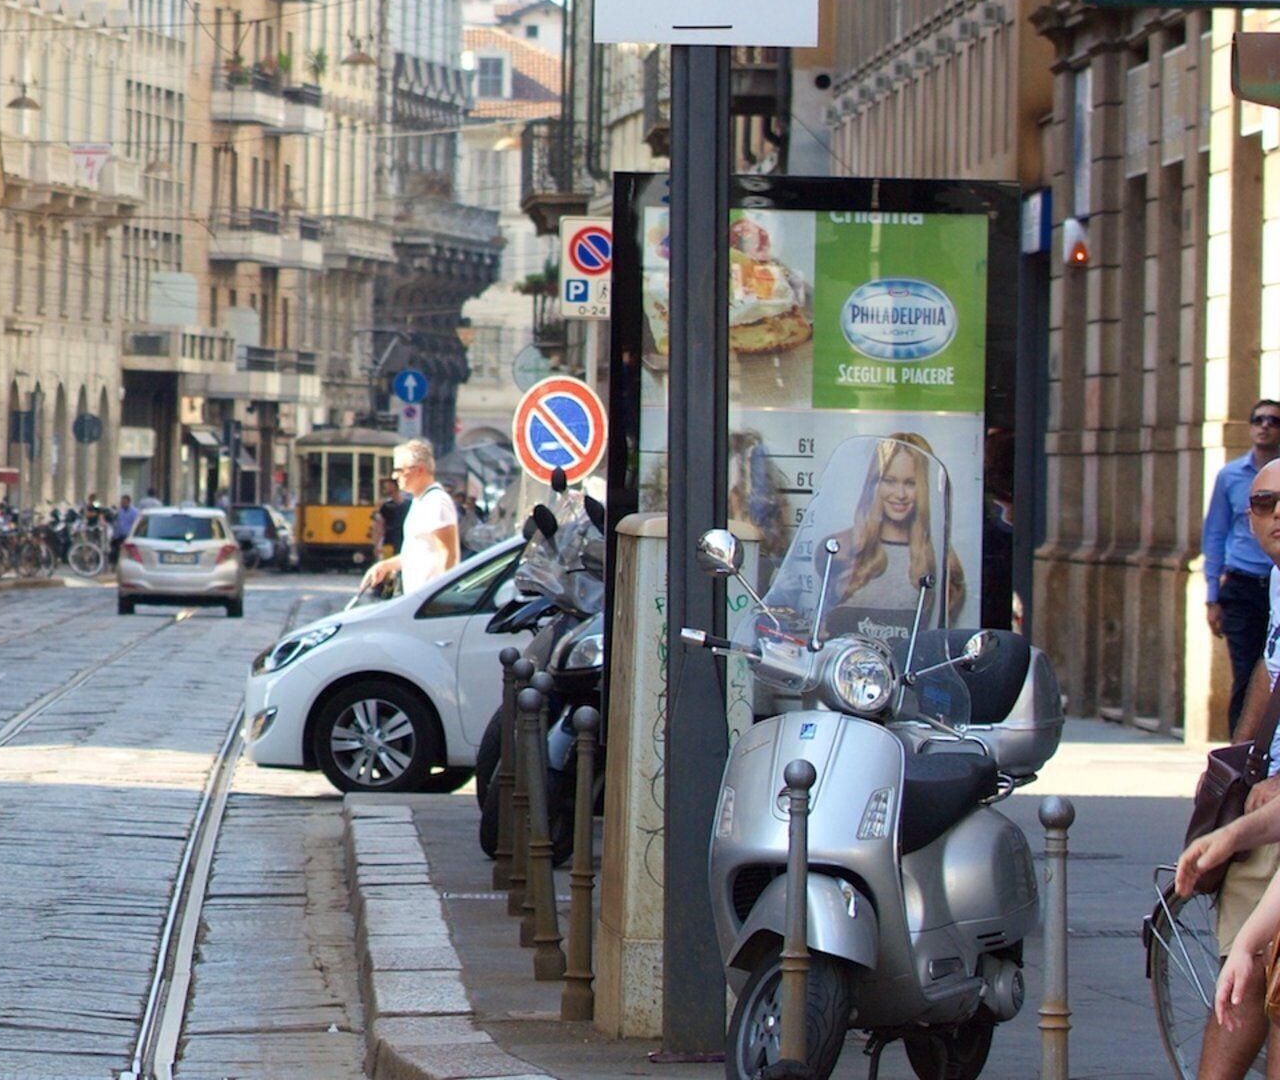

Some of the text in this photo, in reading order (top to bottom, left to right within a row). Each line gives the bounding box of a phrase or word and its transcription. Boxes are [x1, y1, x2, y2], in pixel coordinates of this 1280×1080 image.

[569, 281, 584, 300] P
[851, 304, 946, 326] PHILADELPHIA
[837, 364, 955, 385] SCEGLI IL PIACERE
